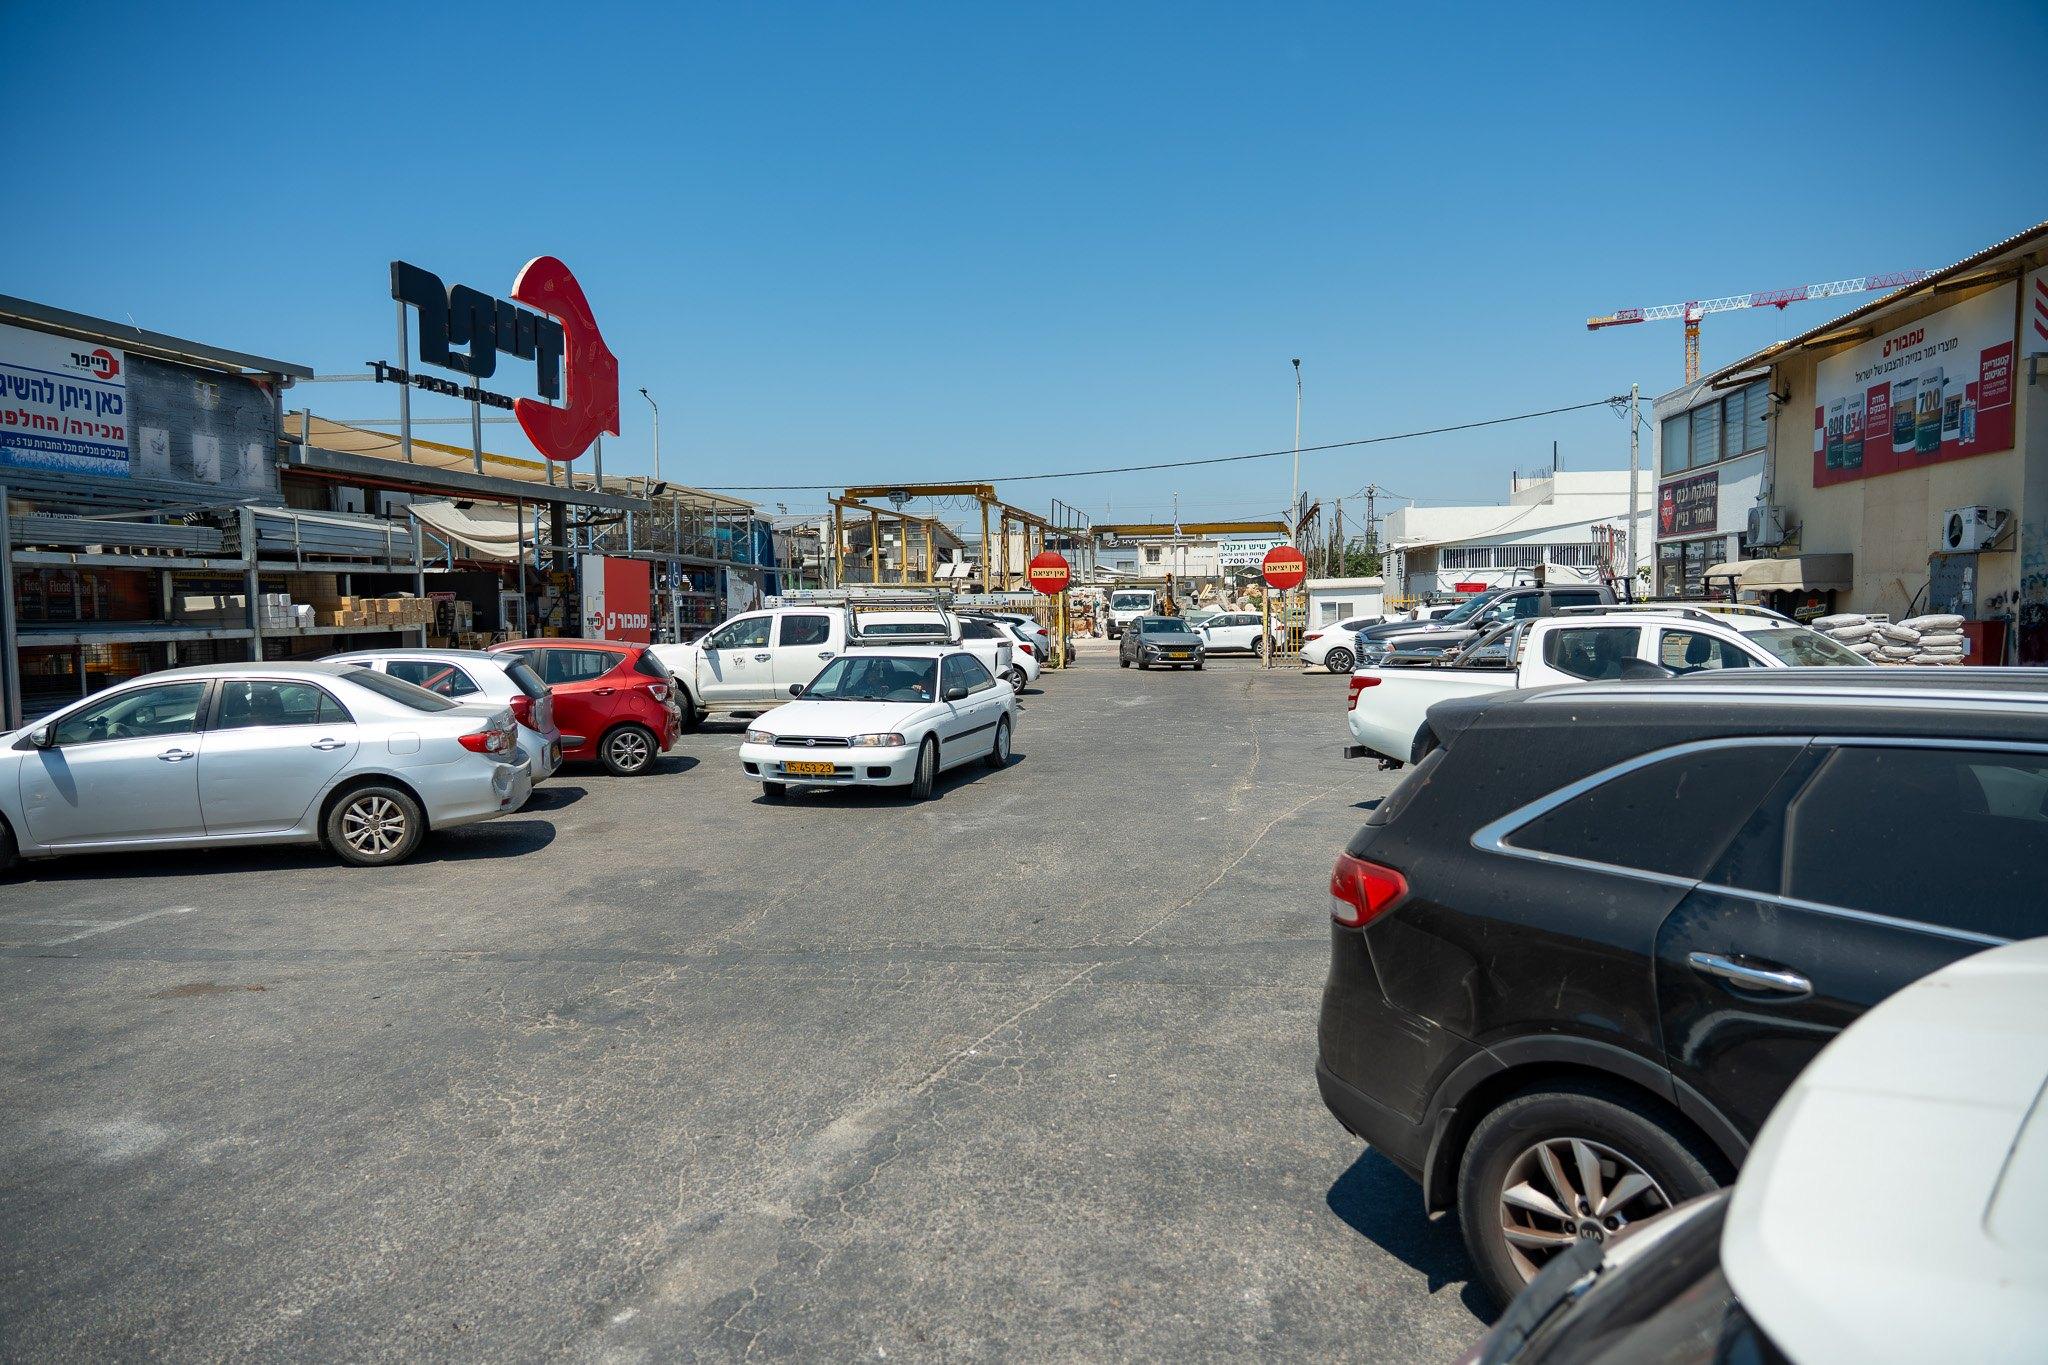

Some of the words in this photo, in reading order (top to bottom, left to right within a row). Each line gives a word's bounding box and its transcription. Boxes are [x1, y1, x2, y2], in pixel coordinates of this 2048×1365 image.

[390, 260, 565, 400] זייפר
[1893, 327, 1924, 351] טמבור
[1938, 337, 1958, 352] מוצרי
[1923, 345, 1936, 358] גמר
[70, 352, 108, 371] זייפר
[1884, 357, 1904, 373] והצבע
[1855, 368, 1872, 384] ישראל
[1873, 364, 1883, 377] של
[59, 384, 92, 412] ניתן
[95, 390, 123, 417] כאן
[1919, 387, 1940, 415] 700
[1828, 414, 1844, 437] 808
[22, 438, 33, 447] עד
[34, 440, 62, 451] החברות
[62, 441, 77, 452] מכל
[78, 445, 99, 455] מכלים
[100, 447, 126, 459] מקבלים
[1676, 488, 1689, 504] גבס
[1690, 479, 1716, 505] מחלקת
[1675, 511, 1689, 533] בניין
[1692, 506, 1714, 524] וחומרי
[1220, 543, 1247, 552] וינקלר
[1220, 557, 1263, 565] 1-700-70-
[1289, 564, 1300, 572] אין
[1796, 605, 1825, 615] Gatorade
[617, 613, 648, 629] טמבור
[1582, 1229, 1601, 1240] KIA
